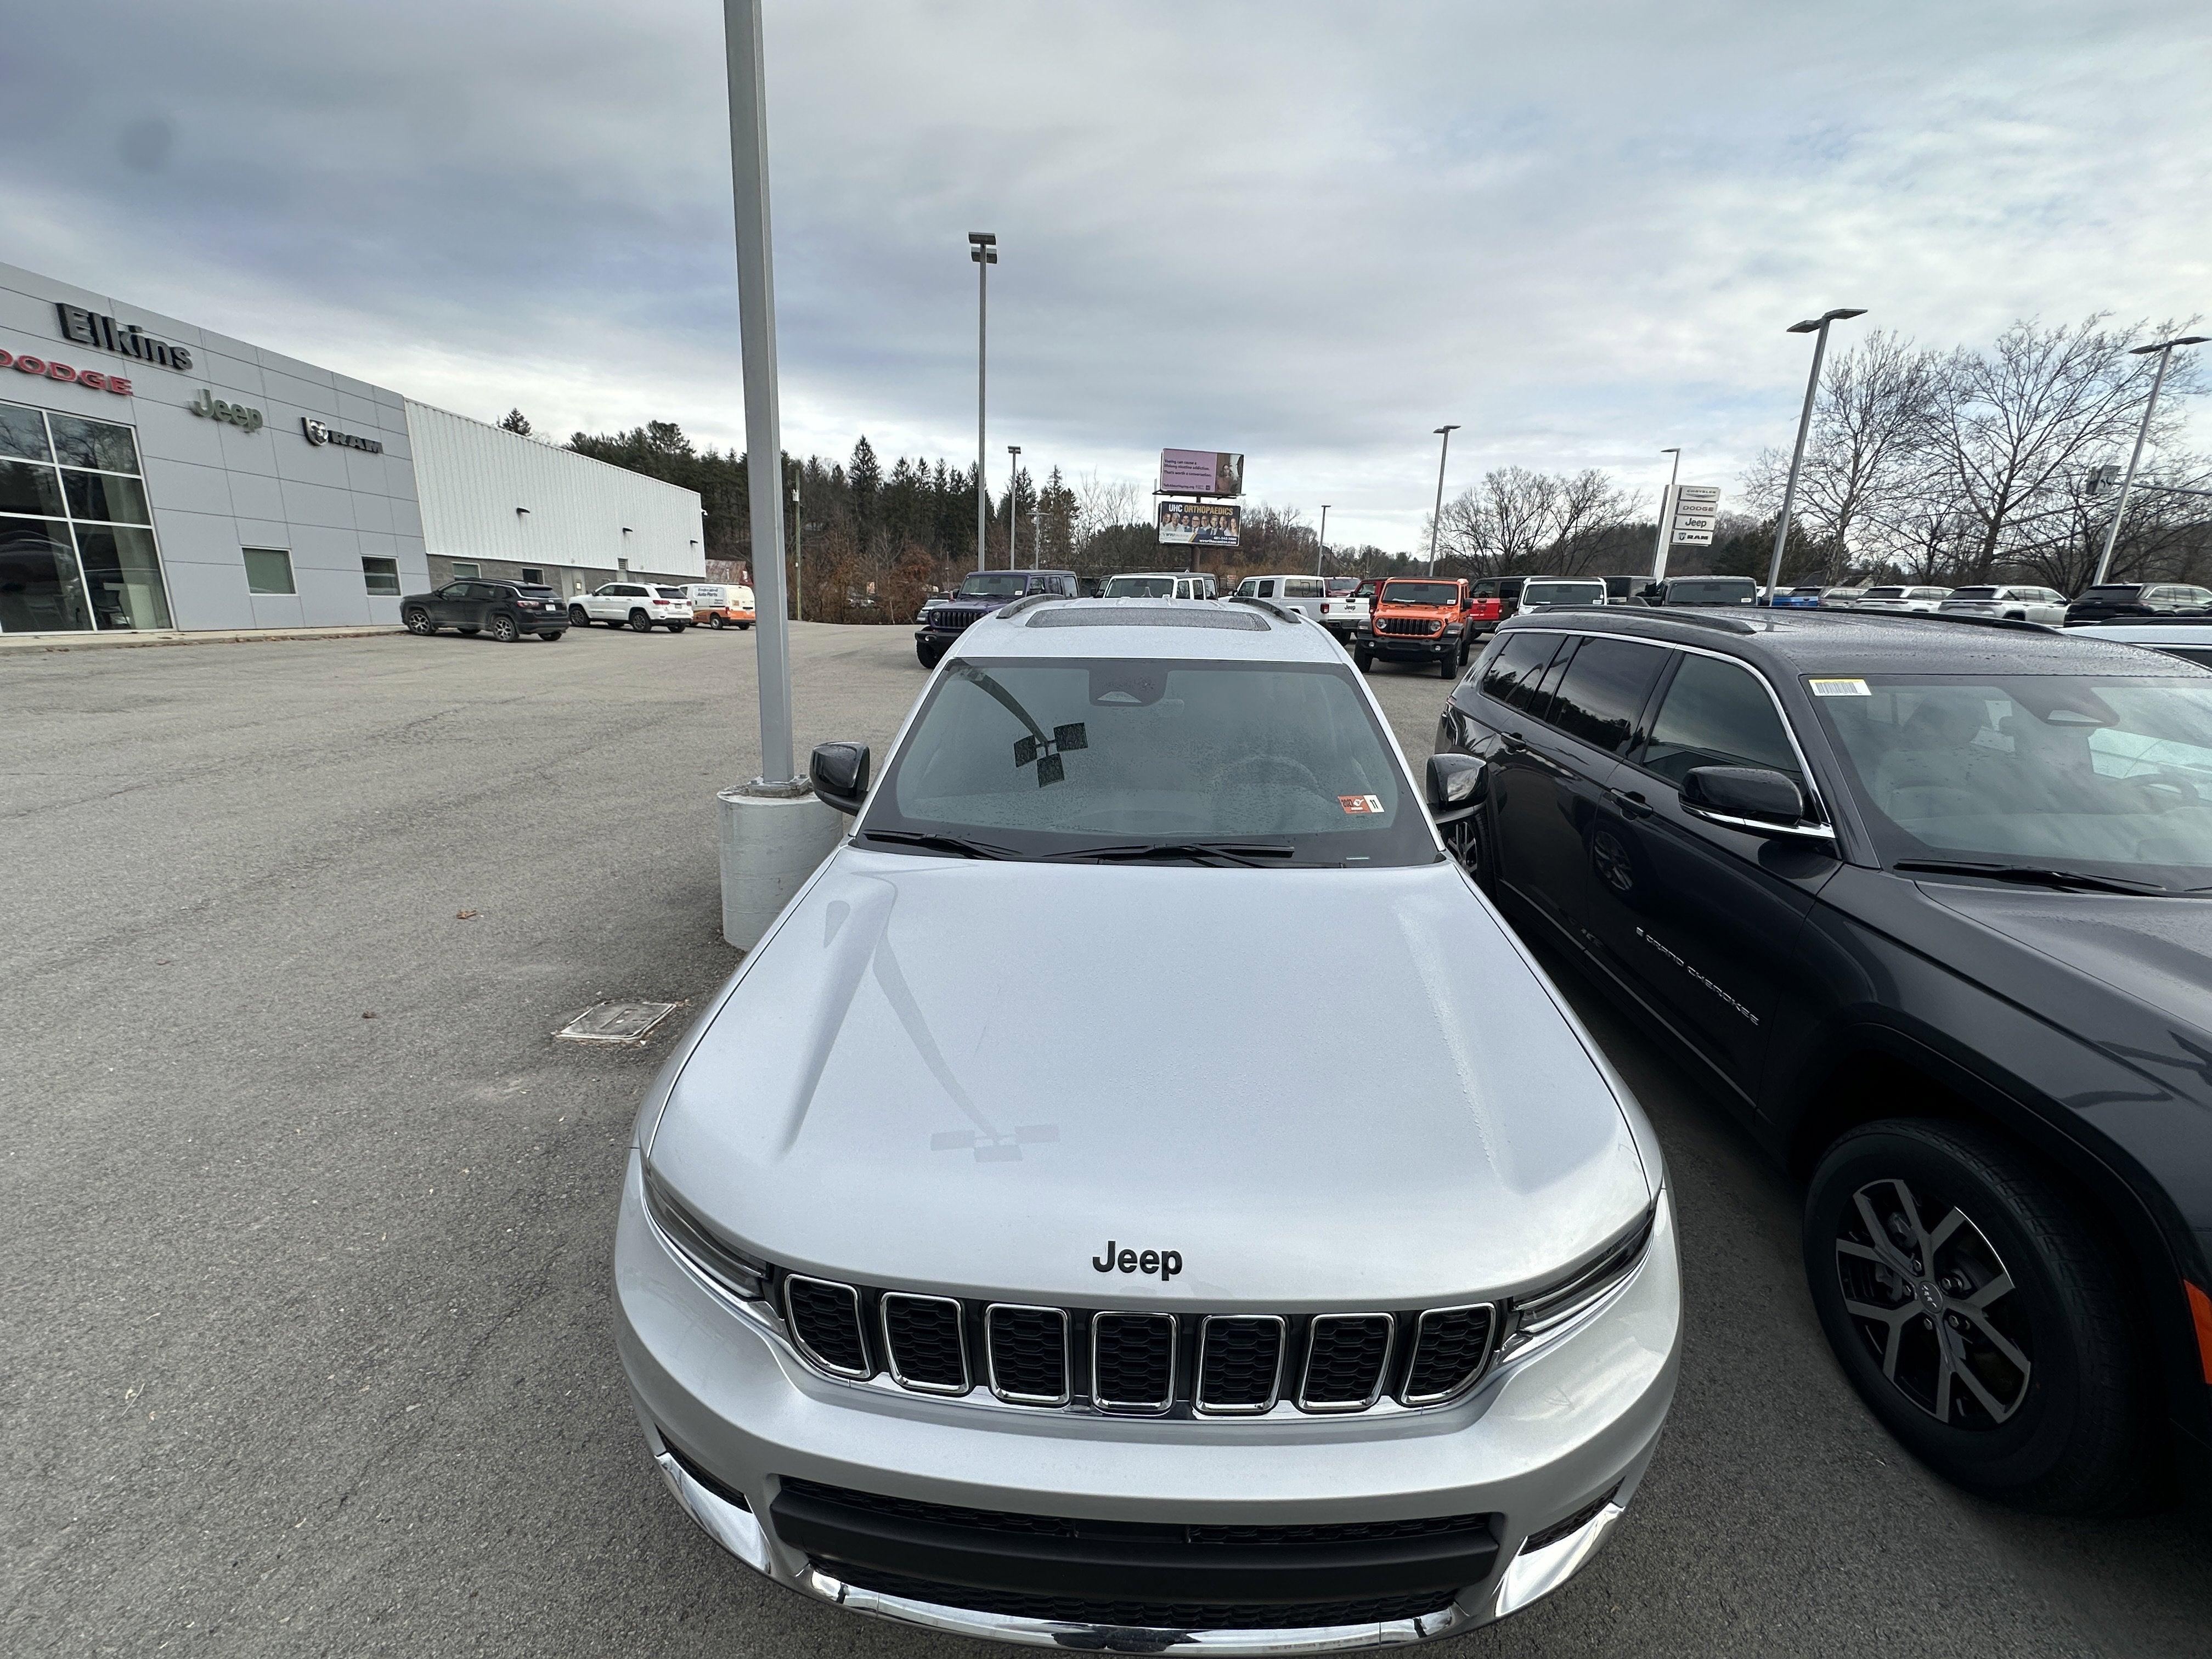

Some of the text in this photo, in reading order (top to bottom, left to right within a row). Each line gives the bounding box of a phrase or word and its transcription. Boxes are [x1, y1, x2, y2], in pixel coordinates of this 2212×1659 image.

[56, 303, 193, 370] Elkins
[191, 388, 263, 433] Jeep
[329, 430, 384, 454] RAM
[1169, 504, 1233, 515] UHC ORTHOPAEDICS
[1685, 517, 1707, 528] Jeep
[1646, 934, 1759, 1026] GRAND CHEROKEE
[1092, 1240, 1183, 1282] Jeep
